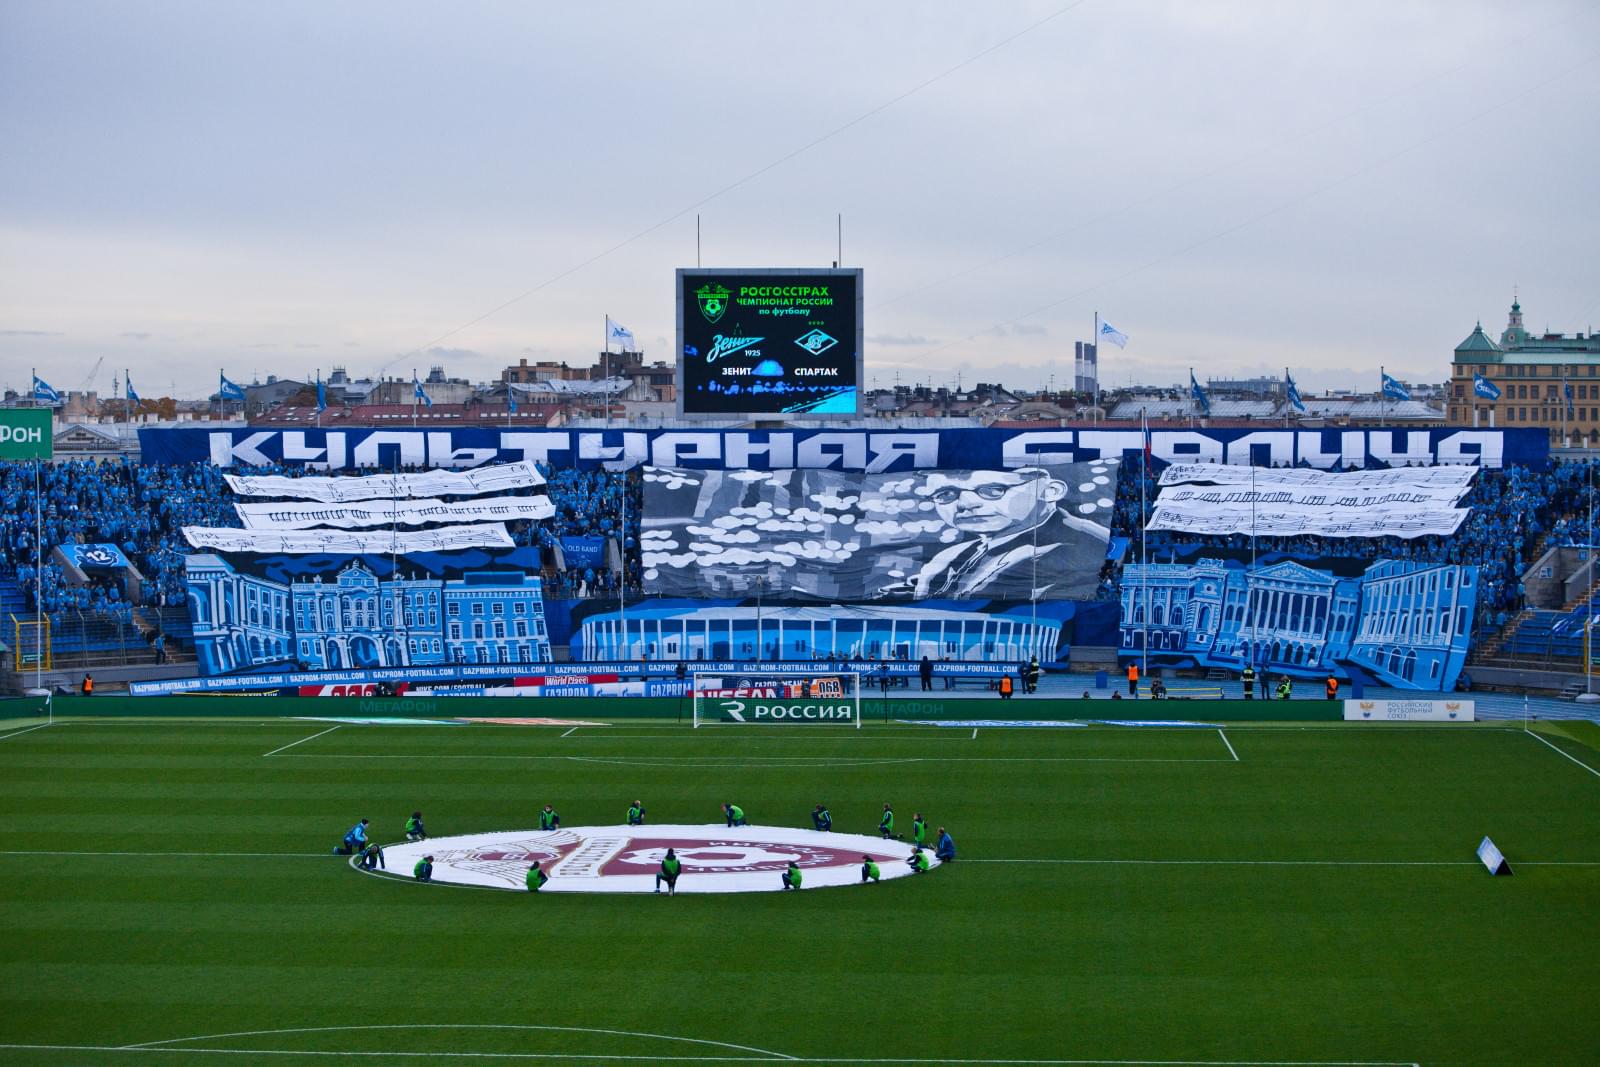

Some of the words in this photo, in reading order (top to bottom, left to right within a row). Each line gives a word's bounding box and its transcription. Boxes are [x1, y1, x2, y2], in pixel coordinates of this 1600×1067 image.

[740, 286, 829, 297] РОСГОССТРАХ
[736, 298, 794, 306] ЧЕМПИОНАТ
[795, 298, 833, 306] РОССИИ
[772, 306, 810, 317] футболу
[744, 349, 761, 357] 1925
[721, 367, 752, 376] ЗЕНИТ
[794, 367, 839, 376] СПАРТАК
[209, 431, 939, 473] КУЛЬТУРНАЯ
[86, 550, 111, 562] 12
[462, 665, 546, 675] GAZPROM-FOOTBALL.COM
[554, 664, 640, 674] GAZPROM-FOOTBALL.COM
[648, 663, 735, 672] GAZPROOOTBALL.COM
[933, 664, 1018, 673] GAZPROM-FOOTBALL.COM
[289, 671, 365, 683] GAZPROM-FOOTBALL.COM
[372, 668, 454, 679] GAZPROM-FOOTBALL.COM
[207, 675, 283, 687] GAZPROM-FOOTBALL.COM
[415, 684, 486, 692] NIKECOM/FOOTBALL
[545, 687, 589, 697] ГАЗПРОМ
[650, 683, 692, 697] GAZPROM
[755, 705, 851, 719] РОССИЯ
